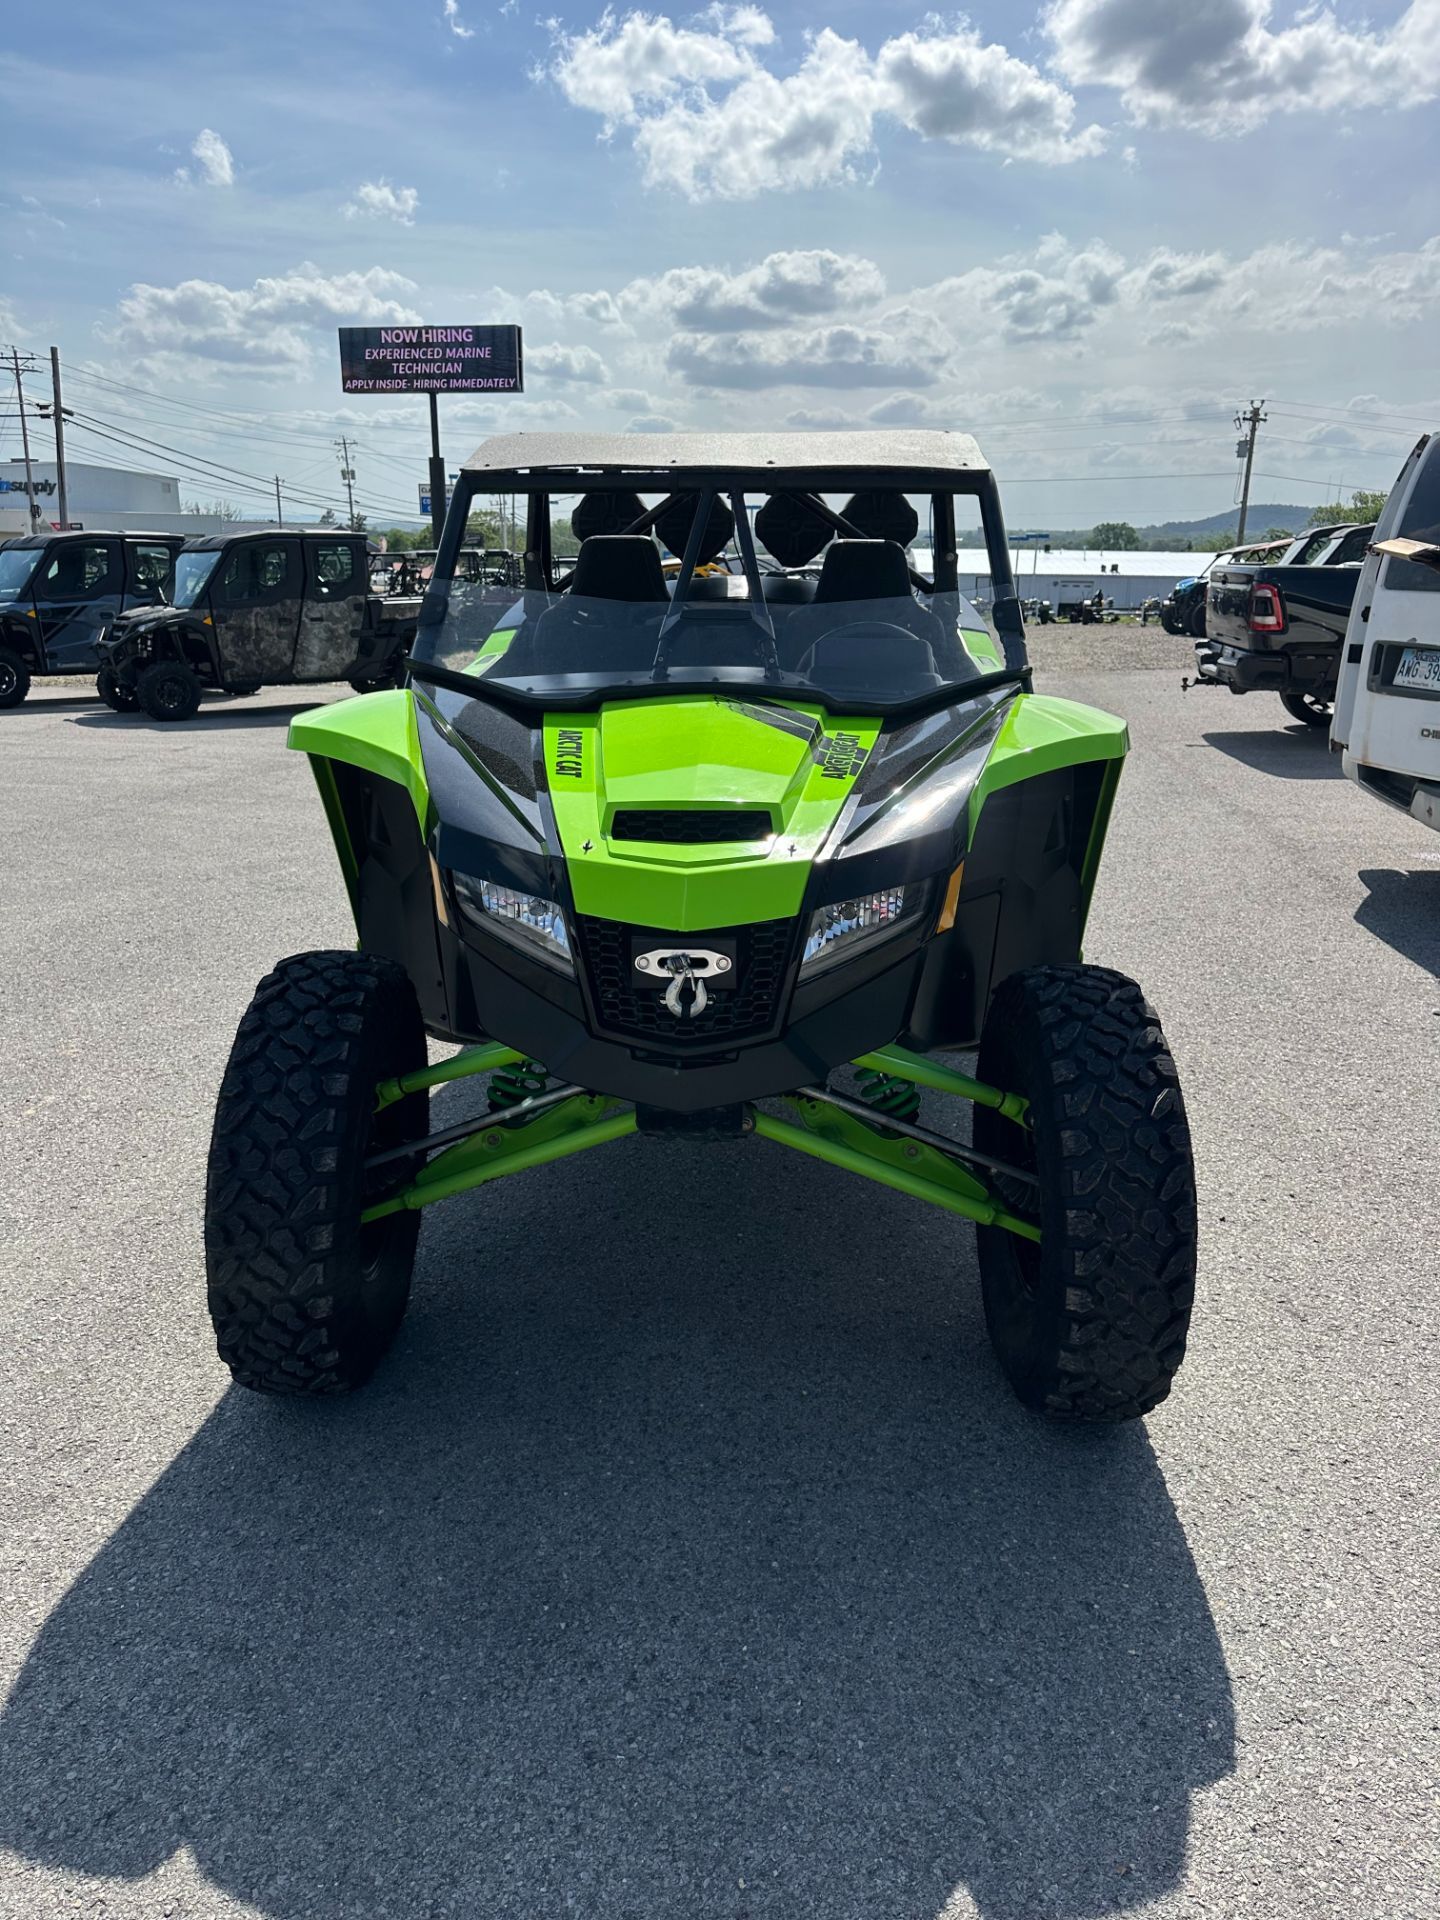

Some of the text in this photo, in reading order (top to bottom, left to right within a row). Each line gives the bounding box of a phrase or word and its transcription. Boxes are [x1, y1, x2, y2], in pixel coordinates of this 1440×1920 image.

[381, 329, 473, 343] NOW HIRING
[365, 347, 492, 360] EXPERIENCED MARINE
[392, 362, 463, 374] TECHNICIAN
[345, 378, 516, 389] APPLY INSIDE- HIRING IMMEDIATELY
[1397, 659, 1421, 678] AWG
[556, 730, 583, 778] ARCTIC CAT
